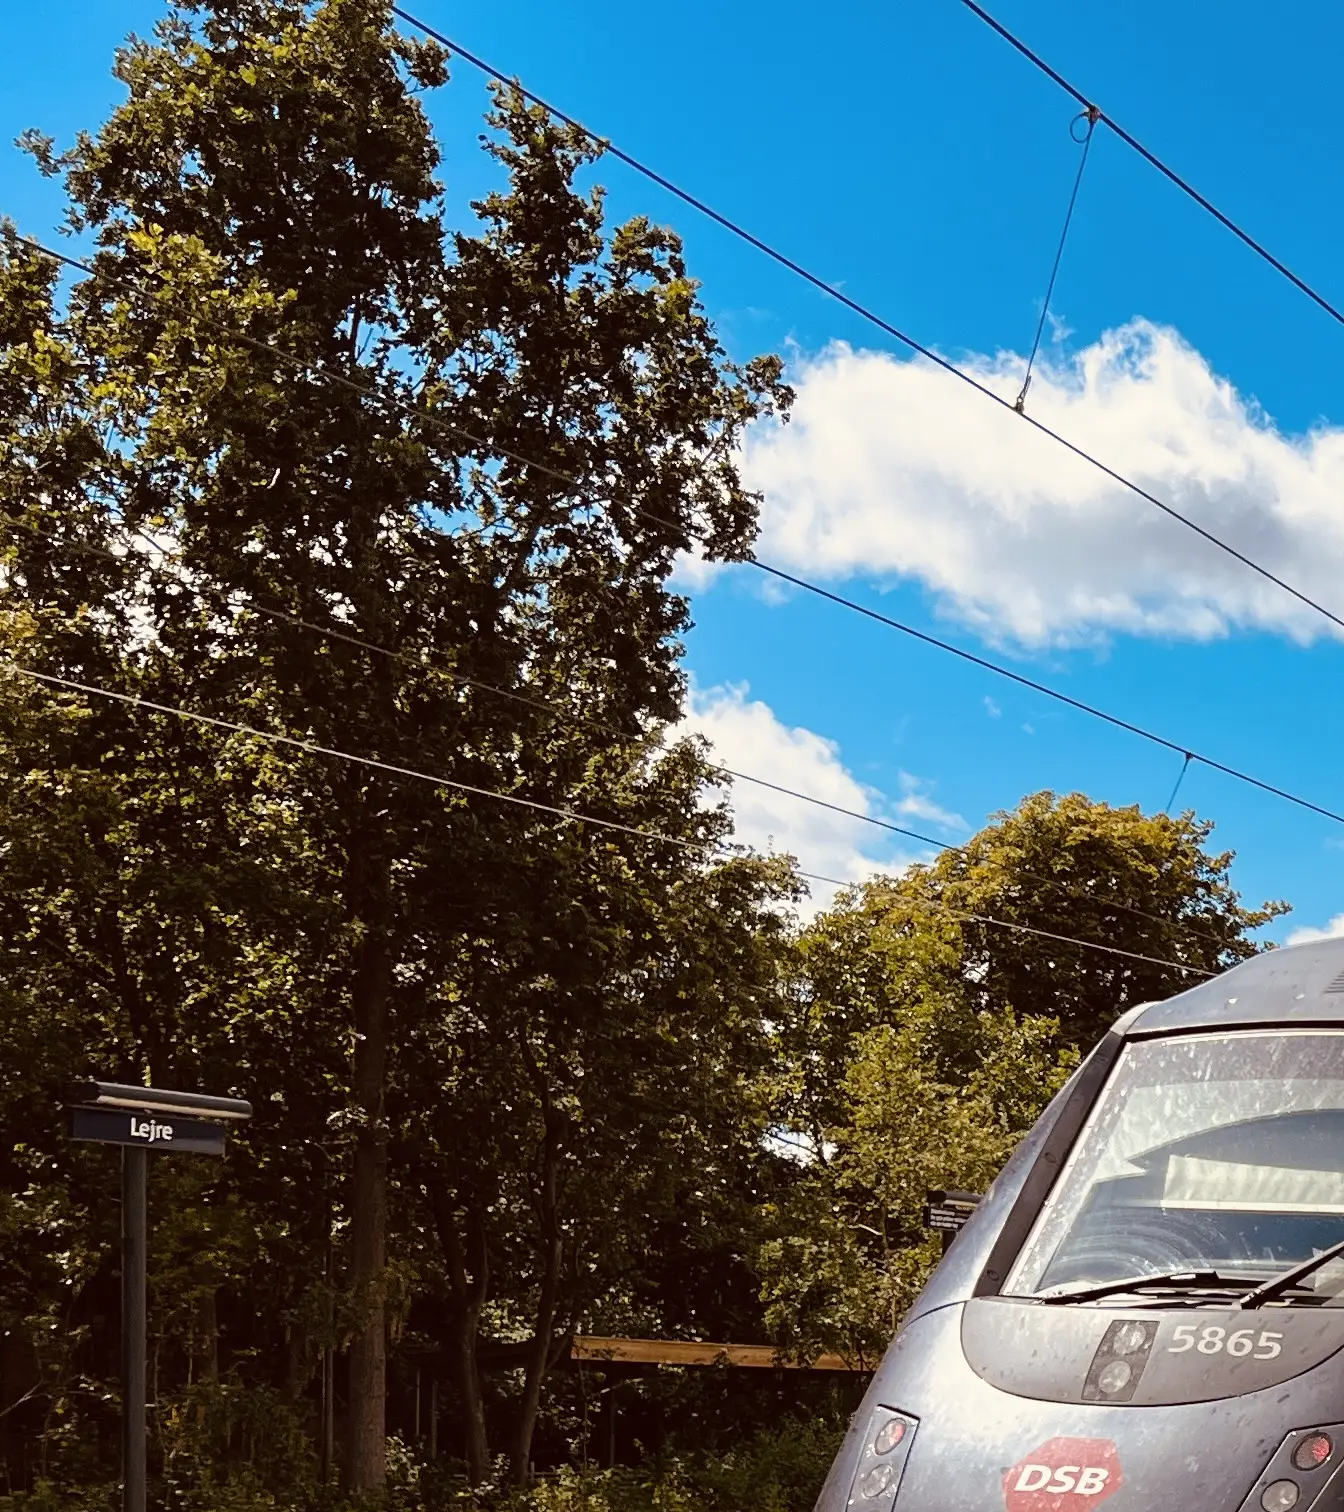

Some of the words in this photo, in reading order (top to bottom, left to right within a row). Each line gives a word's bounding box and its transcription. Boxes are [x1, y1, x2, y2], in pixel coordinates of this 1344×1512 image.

[131, 1117, 173, 1142] Lejre
[1168, 1325, 1284, 1360] 5865
[1014, 1464, 1110, 1496] DSB
